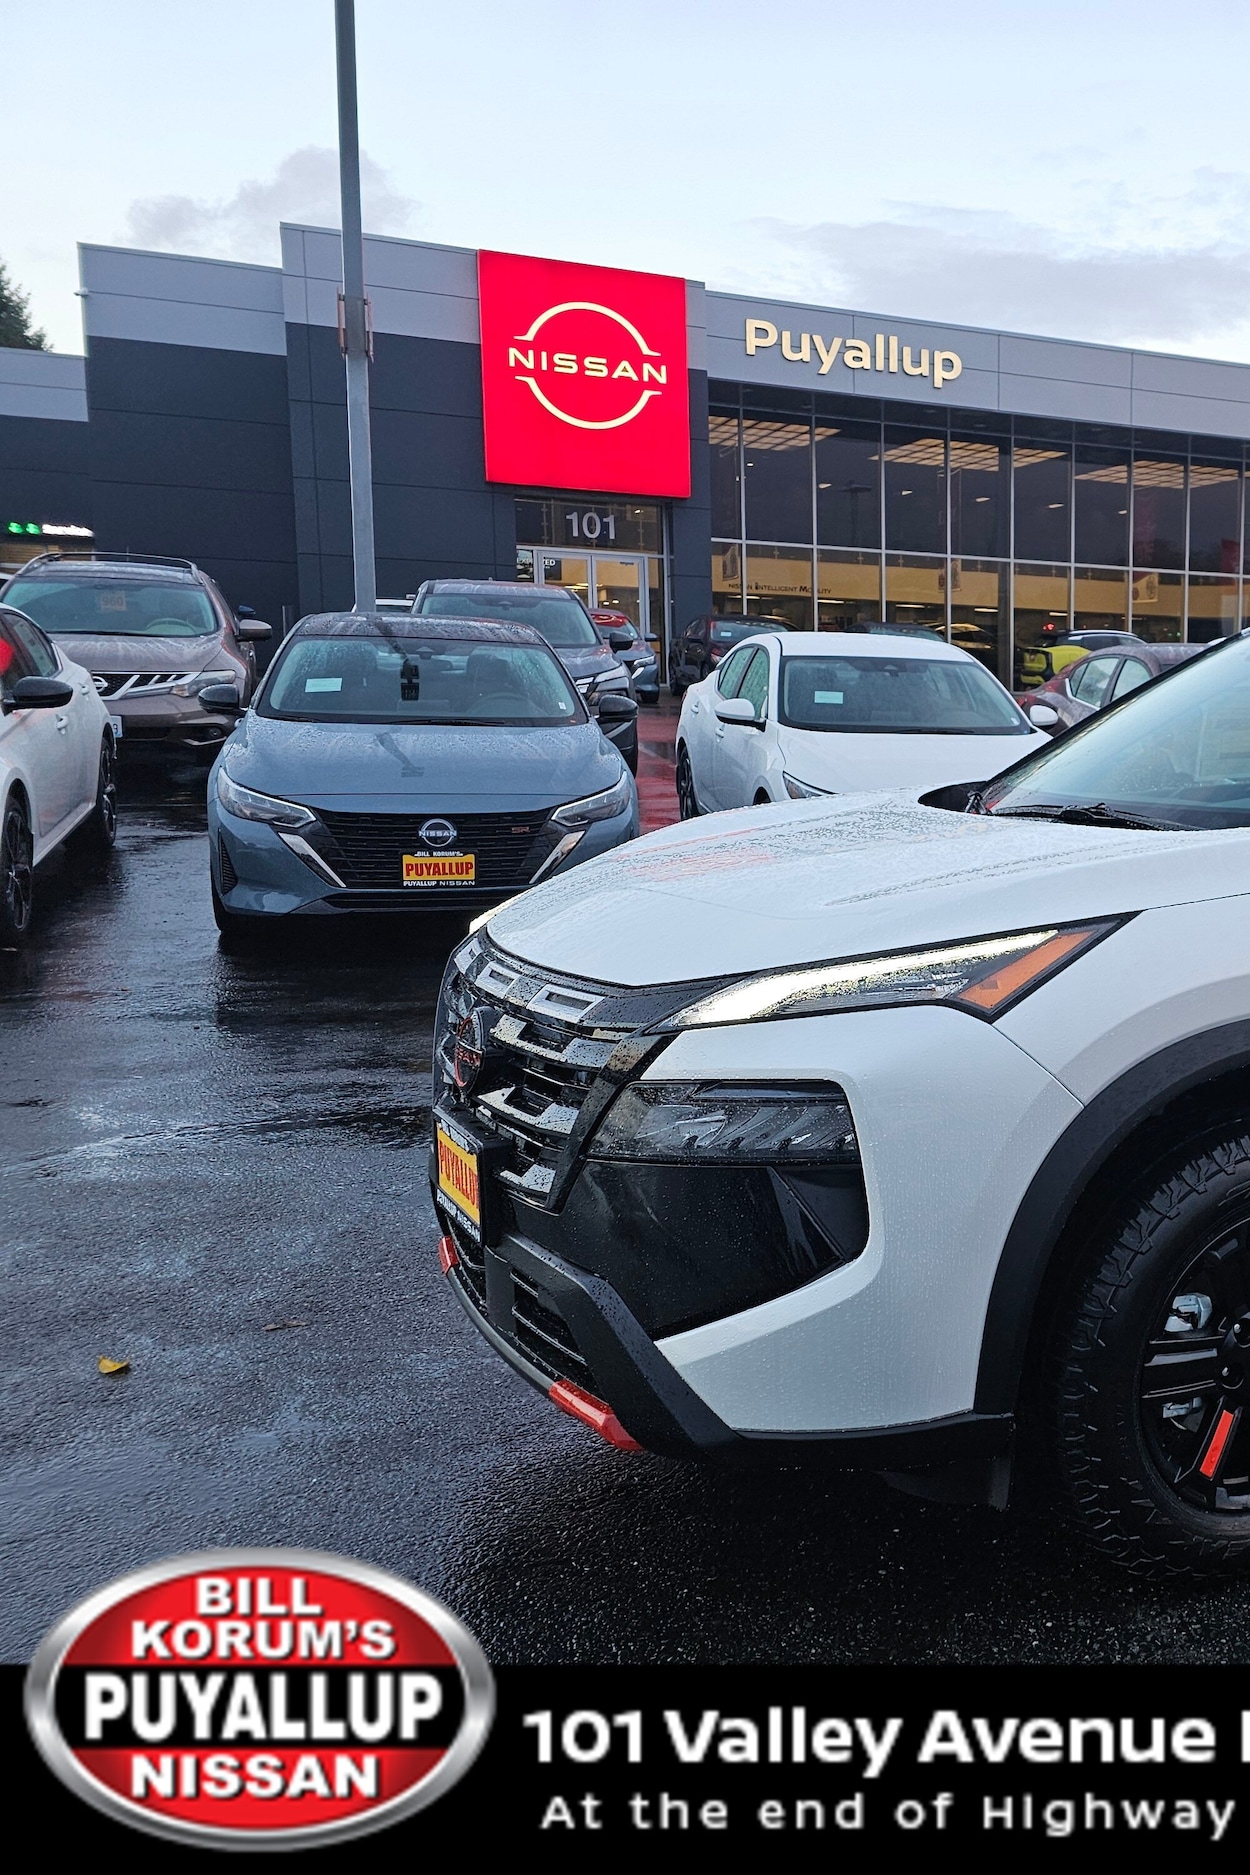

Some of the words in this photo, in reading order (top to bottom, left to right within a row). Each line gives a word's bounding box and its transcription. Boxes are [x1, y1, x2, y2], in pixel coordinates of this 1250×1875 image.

[508, 347, 667, 384] NISSAN
[745, 318, 963, 389] Puyallup
[565, 511, 616, 540] 101
[405, 861, 474, 877] PUYALLUP
